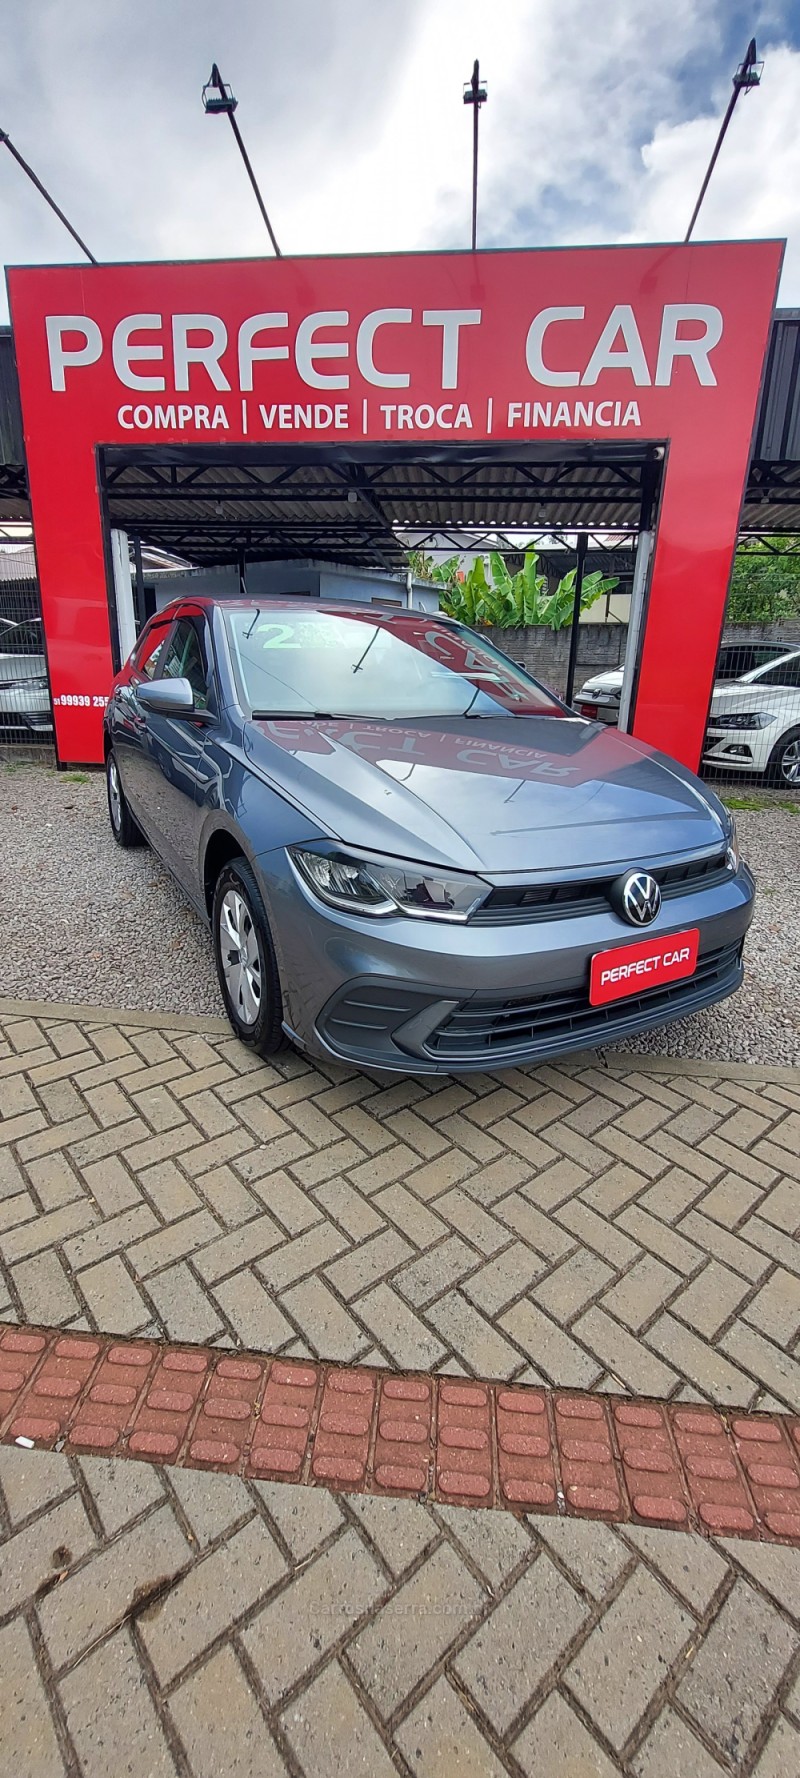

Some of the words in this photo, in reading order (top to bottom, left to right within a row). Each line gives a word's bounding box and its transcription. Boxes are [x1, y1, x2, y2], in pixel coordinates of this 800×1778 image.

[45, 308, 482, 391] PERFECT
[525, 303, 724, 388] CAR
[117, 404, 230, 429] COMPRA
[258, 404, 349, 429] VENDE
[380, 403, 473, 429] TROCA
[507, 401, 642, 428] FINANCIA
[61, 695, 90, 706] 99939
[600, 956, 661, 986] PERFECT
[662, 947, 690, 967] CAR
